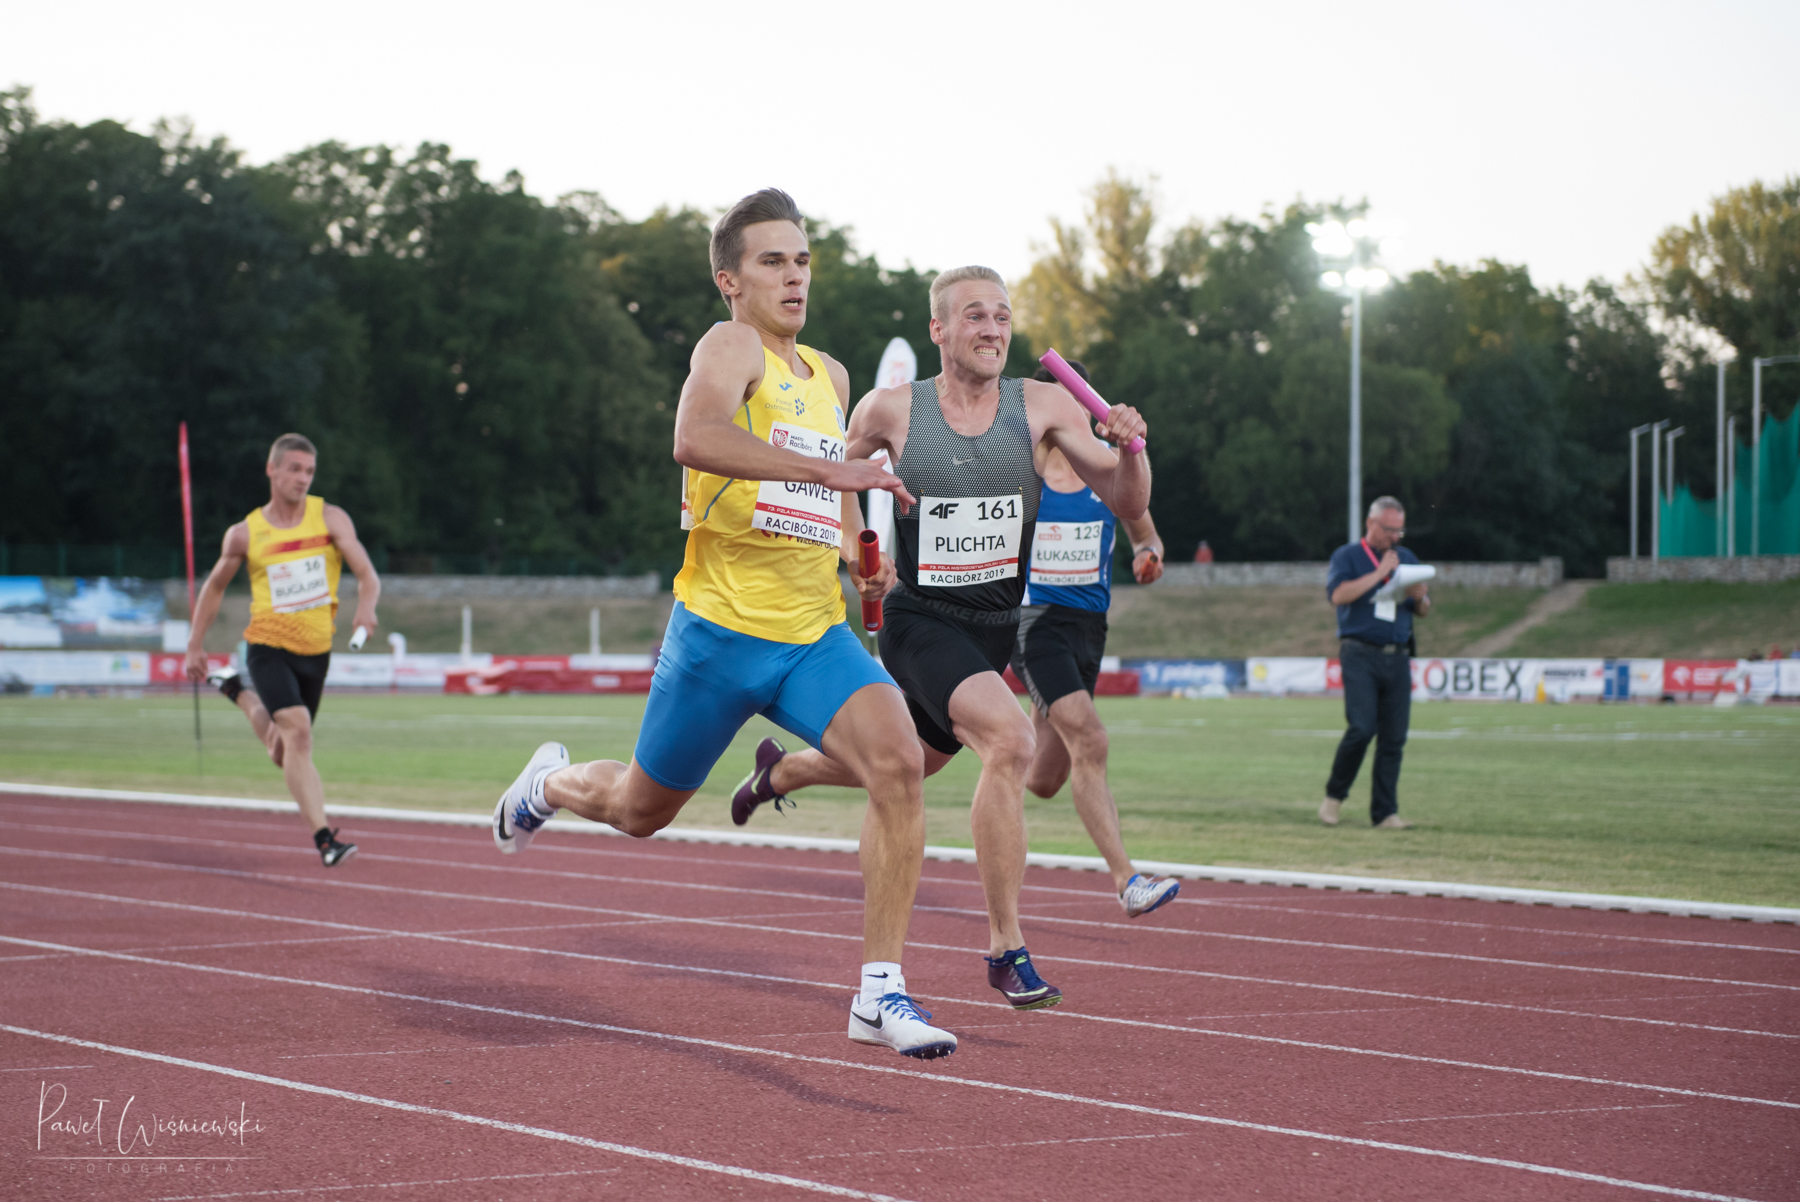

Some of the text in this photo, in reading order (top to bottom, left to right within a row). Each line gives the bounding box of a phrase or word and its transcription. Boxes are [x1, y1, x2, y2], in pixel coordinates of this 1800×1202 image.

[819, 439, 844, 462] 561
[928, 502, 960, 519] 4F
[977, 499, 1018, 521] 161
[765, 516, 818, 537] RACIBÓRZ
[819, 528, 836, 541] 2019
[1074, 524, 1101, 540] 123
[935, 535, 1006, 553] PLICHTA
[1036, 549, 1098, 562] ŁUKASZEK
[305, 559, 321, 573] 16
[930, 568, 1005, 584] RACIBÓRZ 2019
[972, 611, 1008, 625] PRO
[1409, 659, 1522, 701] OBEX
